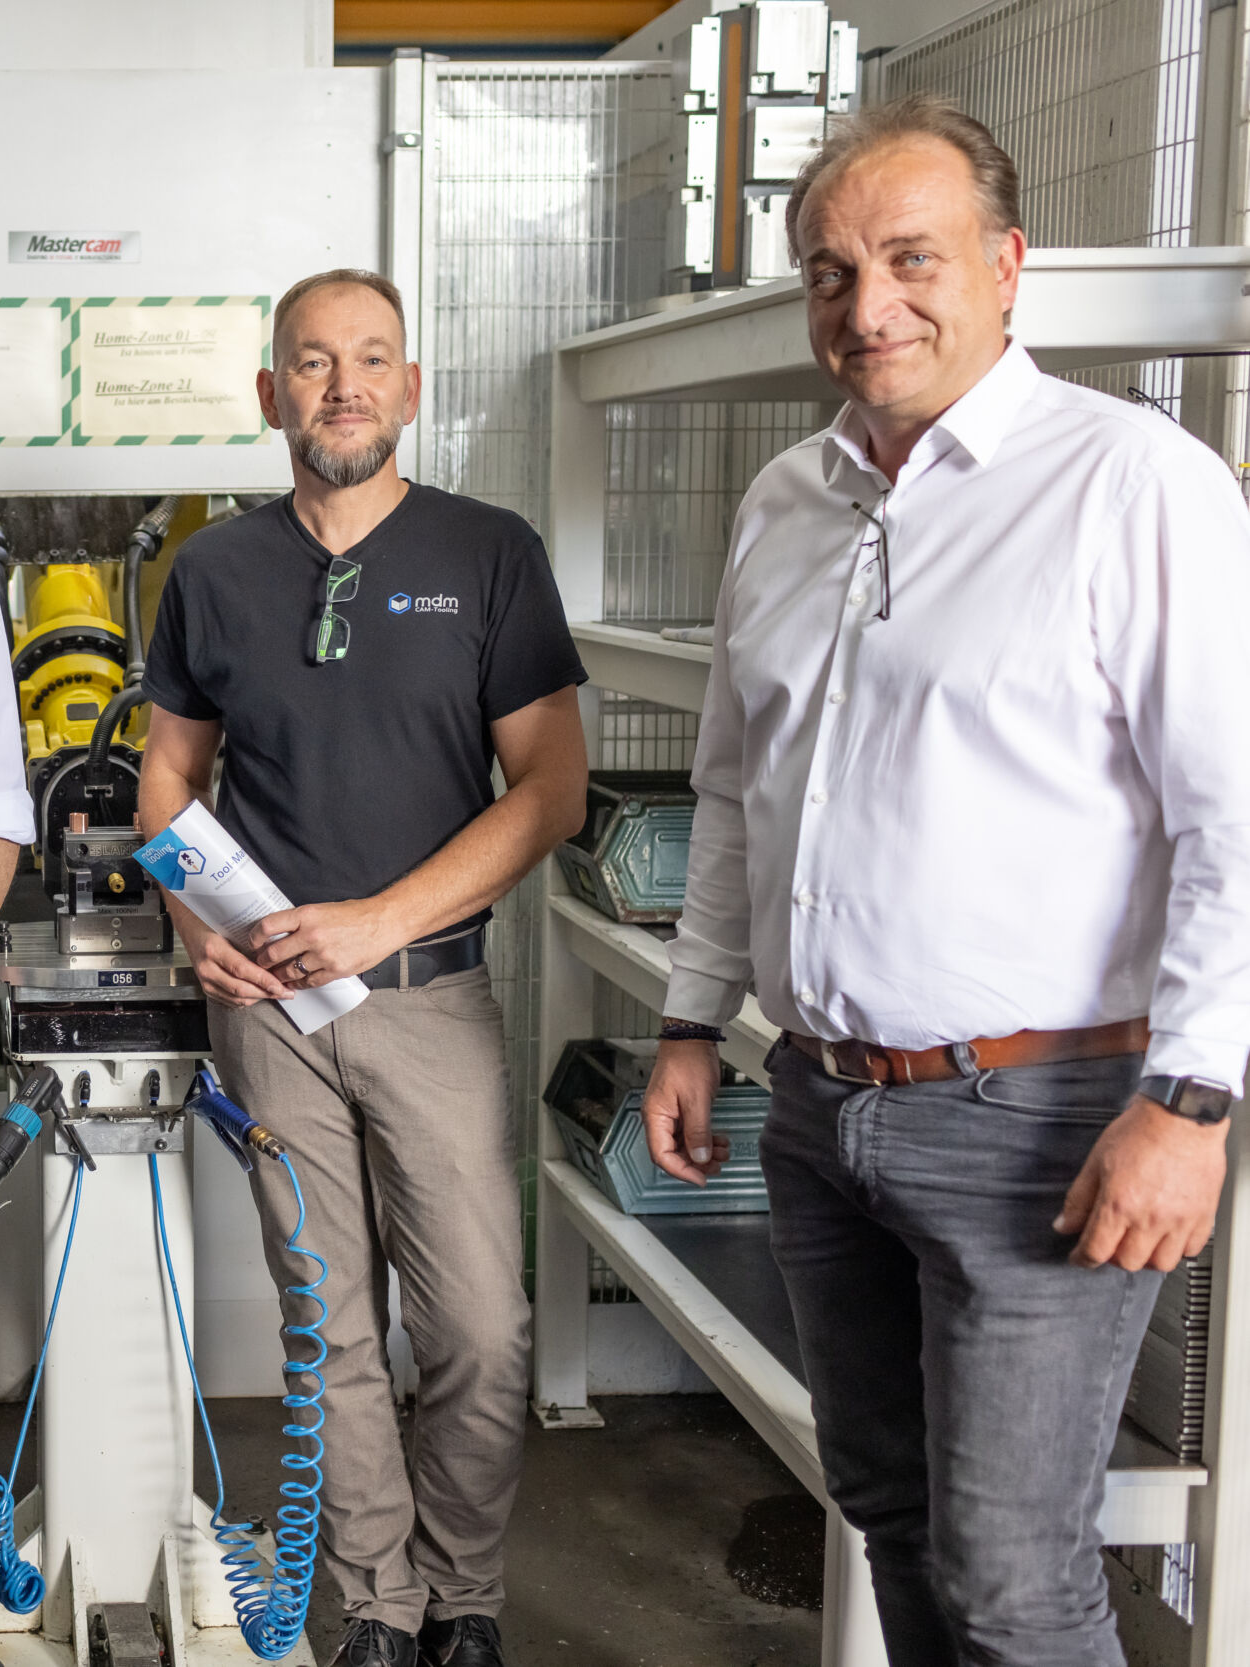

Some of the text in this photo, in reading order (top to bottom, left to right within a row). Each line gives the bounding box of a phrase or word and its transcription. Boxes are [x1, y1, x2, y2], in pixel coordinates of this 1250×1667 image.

[26, 235, 122, 253] Mastercam
[94, 330, 172, 345] Home-Zone
[175, 328, 190, 342] 01
[95, 378, 193, 393] Home-Zone 21
[127, 396, 145, 406] hier
[147, 397, 161, 405] am
[414, 593, 459, 608] mdm
[146, 843, 175, 865] tooling
[210, 860, 234, 882] Tool
[112, 973, 133, 984] 056
